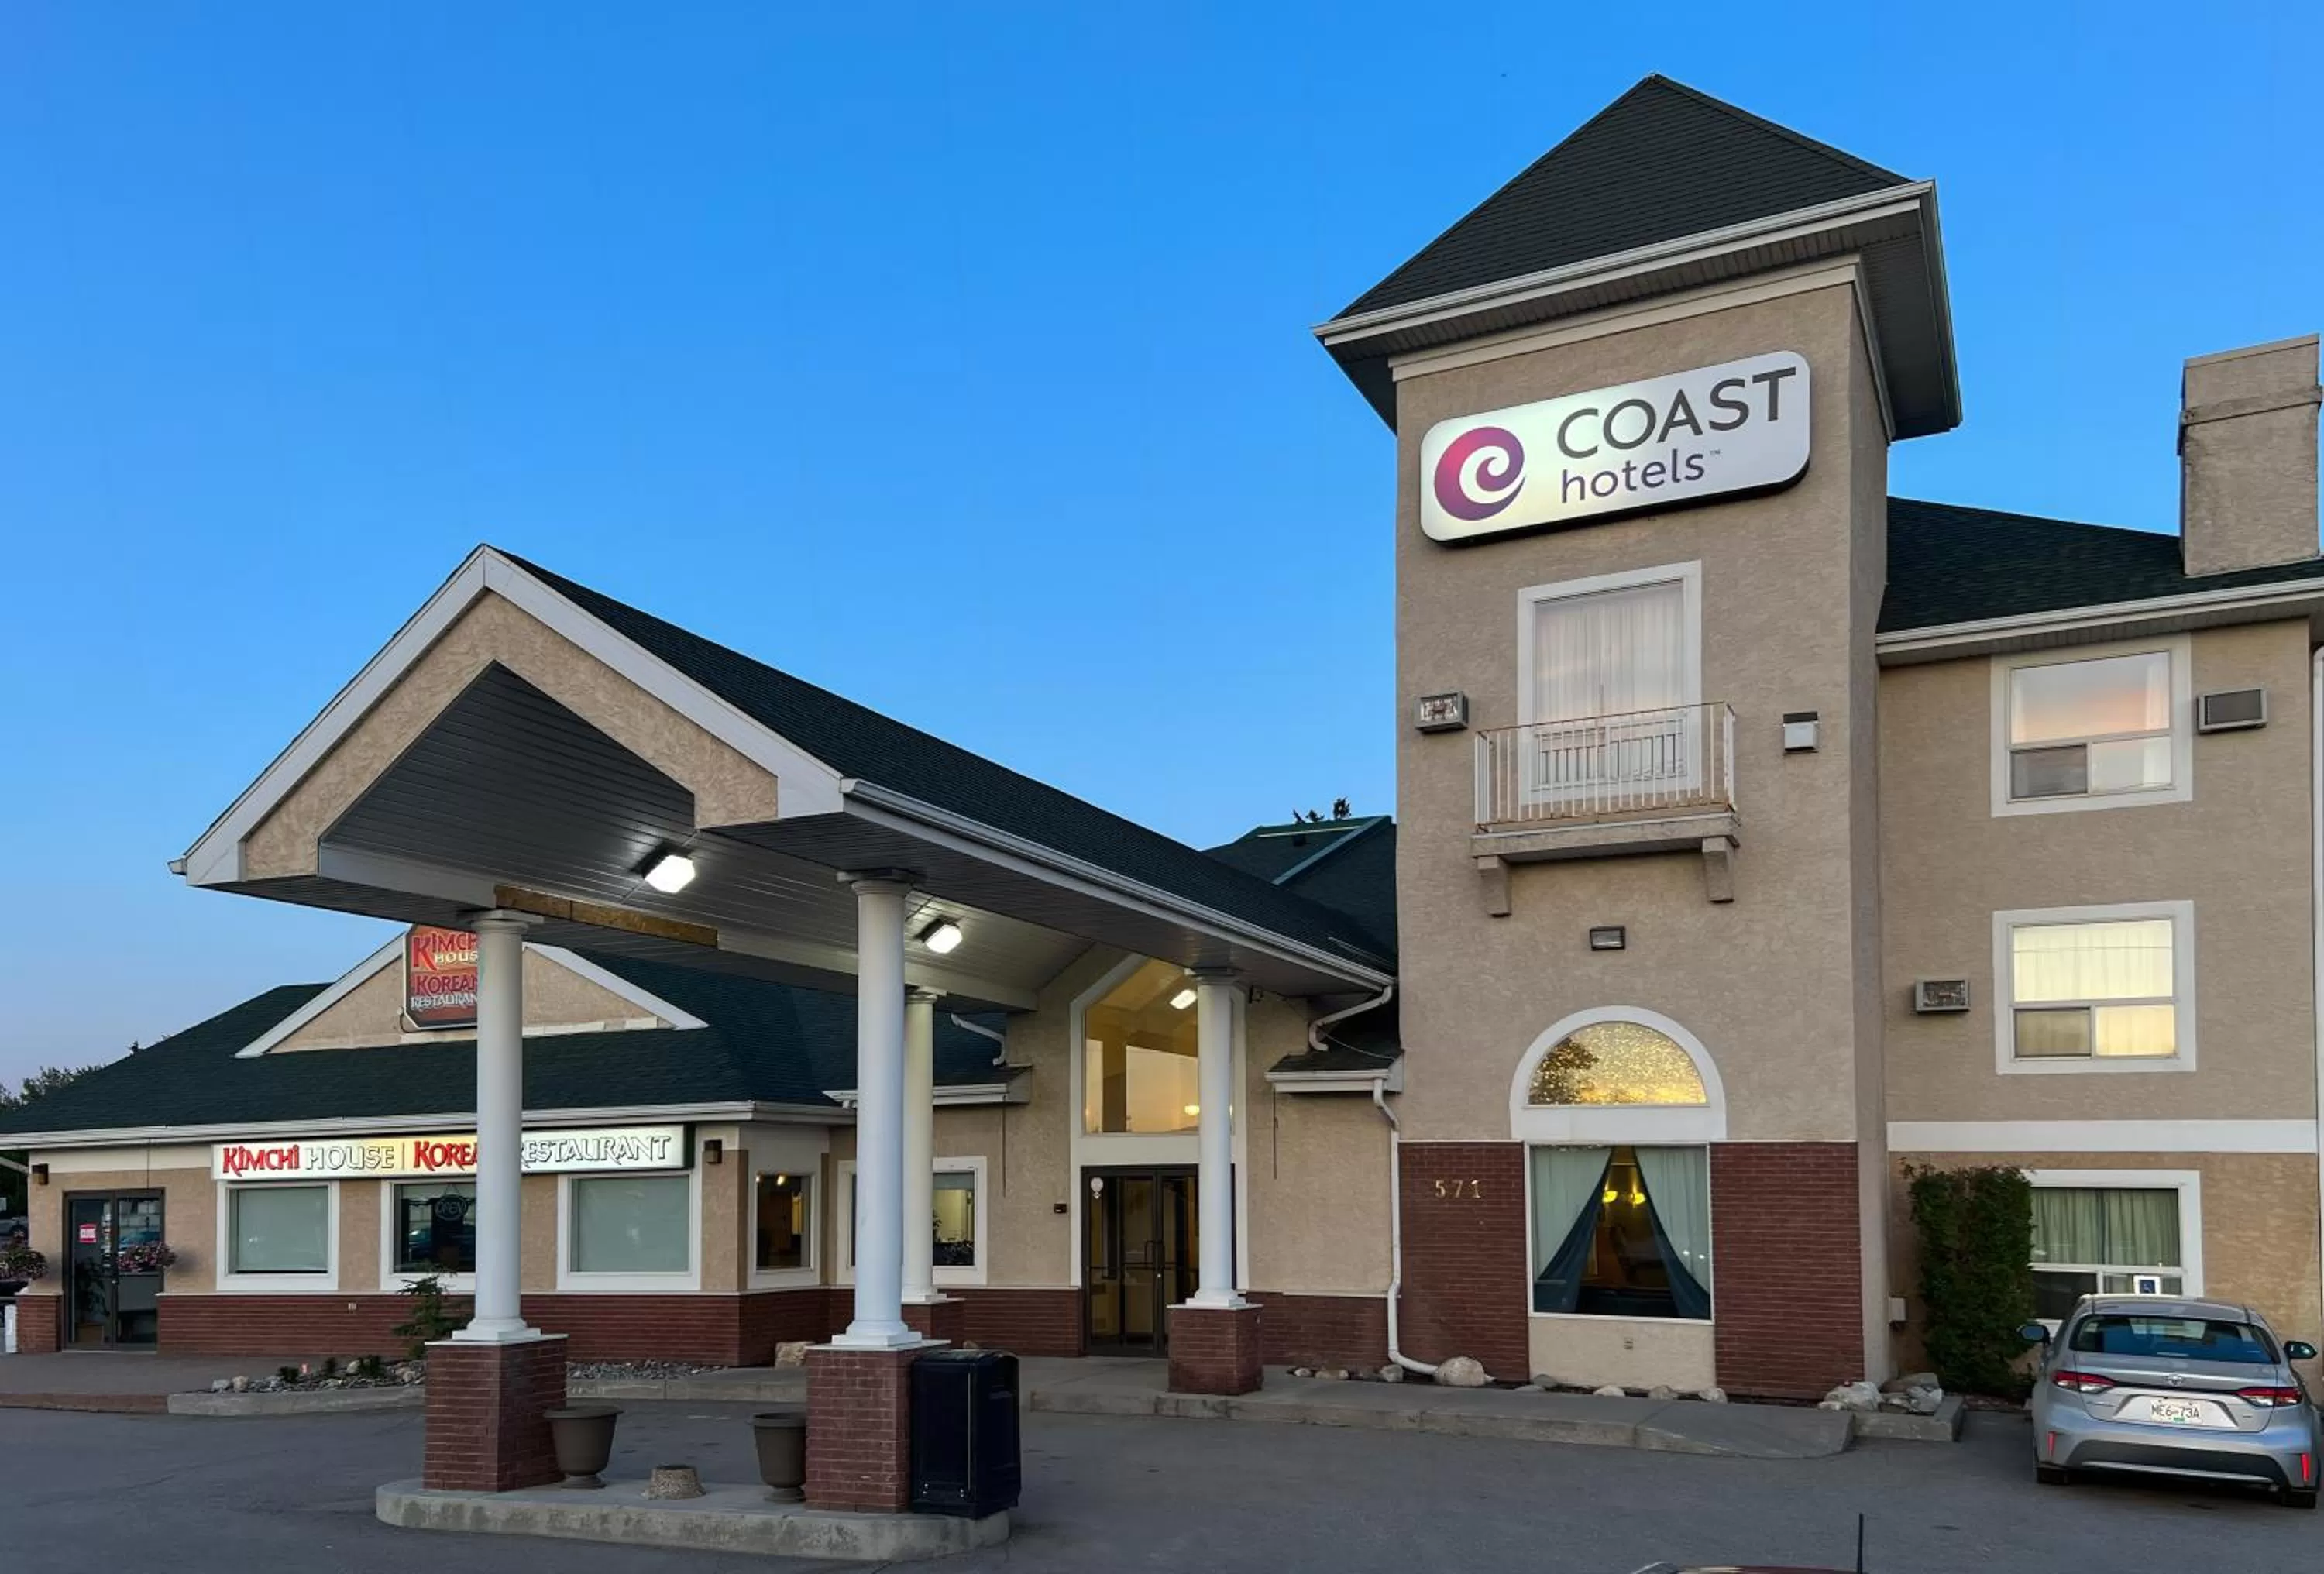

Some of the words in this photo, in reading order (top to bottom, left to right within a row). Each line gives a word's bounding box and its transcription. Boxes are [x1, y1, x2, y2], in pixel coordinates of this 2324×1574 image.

[1557, 366, 1796, 459] COAST
[1561, 448, 1705, 503] hotels
[412, 932, 478, 971] KIMCH
[435, 951, 478, 964] HOUS
[411, 993, 478, 1010] RESTAURAN
[305, 1146, 394, 1170] HOUSE
[413, 1140, 478, 1172] KORE
[1435, 1180, 1481, 1198] 571
